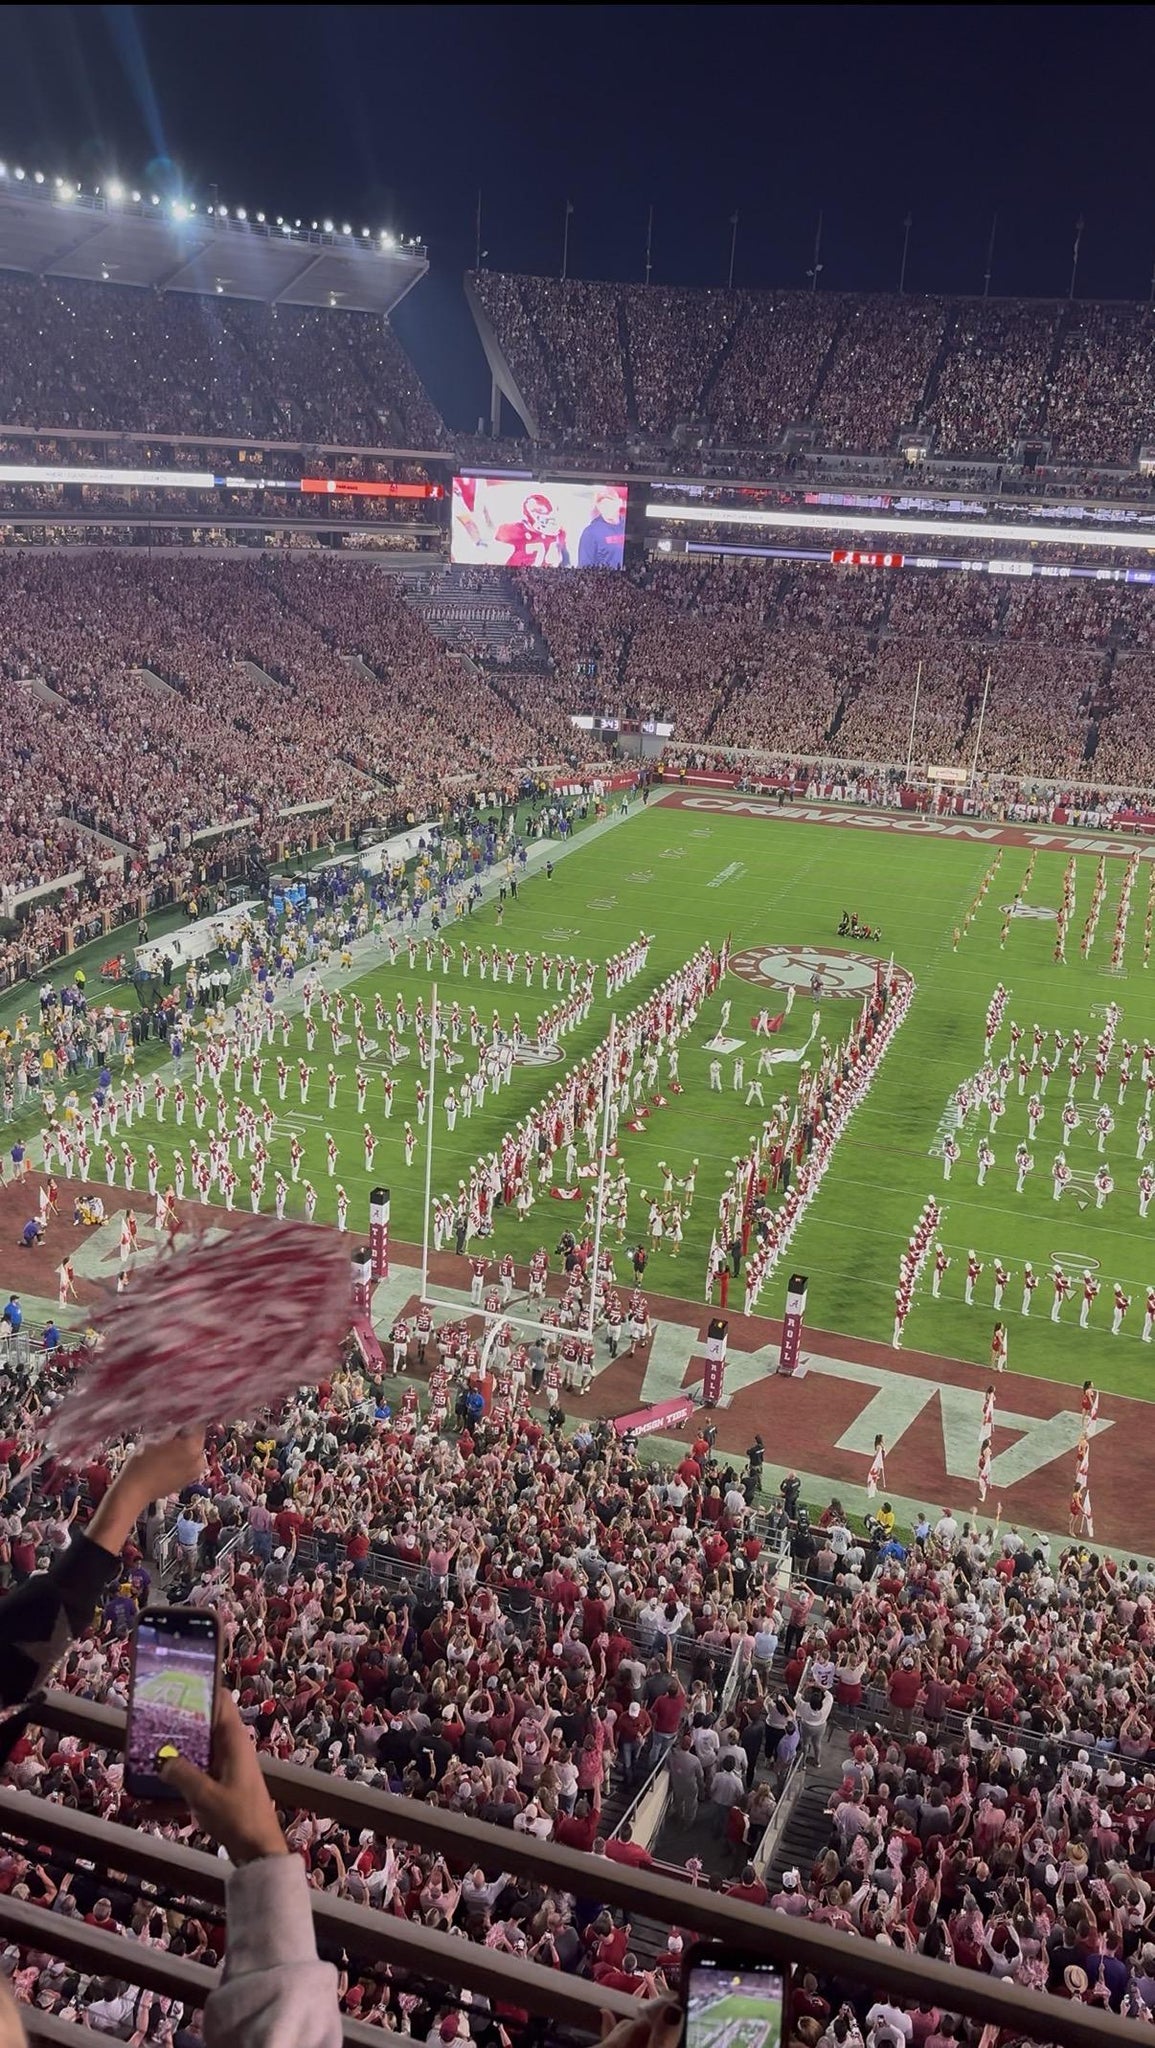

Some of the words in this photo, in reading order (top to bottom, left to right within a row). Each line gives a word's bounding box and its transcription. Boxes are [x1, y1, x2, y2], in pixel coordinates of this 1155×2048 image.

[916, 558, 938, 568] DOWN
[1041, 567, 1058, 576] BALL
[1059, 568, 1071, 577] ON
[682, 797, 1003, 839] CRIMSON
[487, 1303, 496, 1311] 10
[784, 1318, 795, 1361] ROLL
[468, 1355, 474, 1364] 6
[708, 1364, 717, 1399] ROLL
